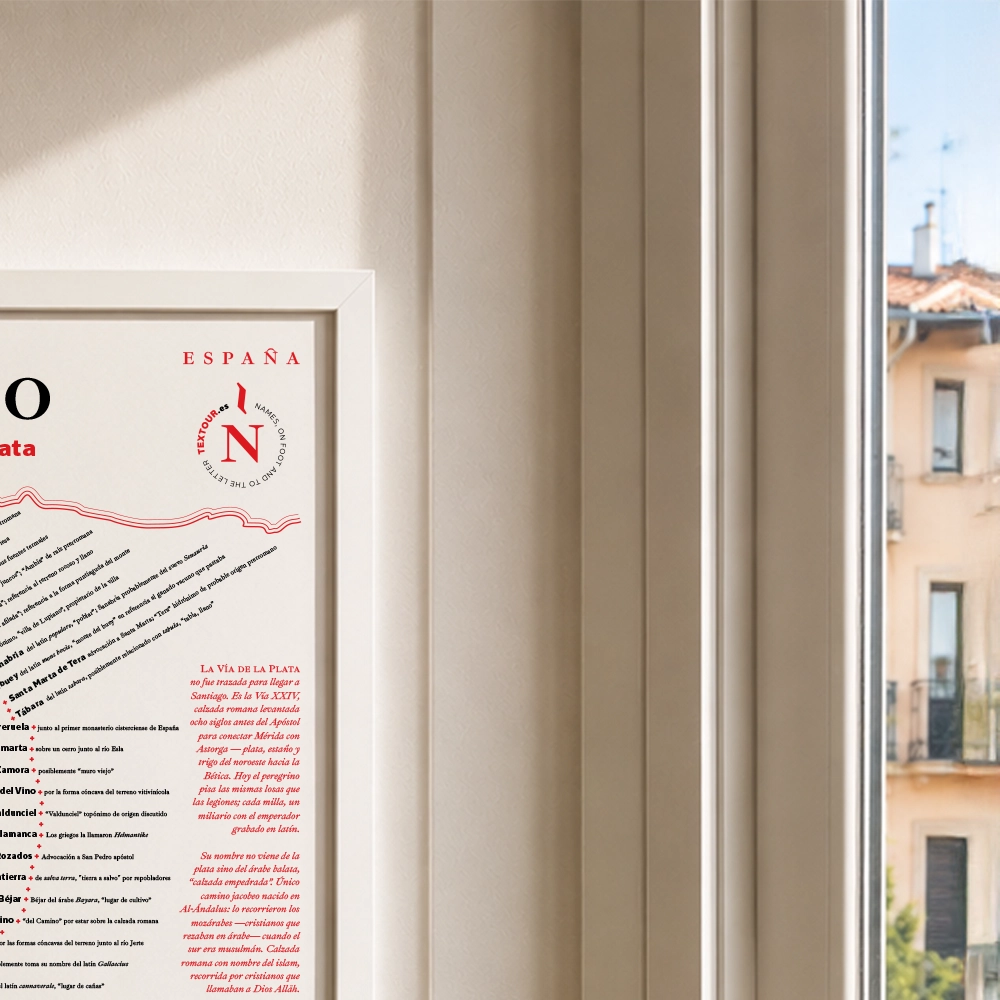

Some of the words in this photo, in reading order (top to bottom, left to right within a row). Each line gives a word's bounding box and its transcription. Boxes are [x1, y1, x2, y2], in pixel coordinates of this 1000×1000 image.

[183, 347, 299, 365] ESPAÑA
[254, 402, 280, 427] NAMES,
[197, 403, 230, 455] TEXTOUR.es
[277, 428, 286, 441] ON
[275, 442, 287, 467] FOOT
[202, 459, 229, 485] LETTER
[261, 465, 277, 482] AND
[230, 480, 247, 488] THE
[249, 478, 262, 488] TO
[201, 664, 214, 673] LA
[217, 664, 235, 673] VÍA
[269, 664, 300, 673] PLATA
[8, 685, 33, 702] Santa
[32, 672, 57, 688] Marta
[57, 665, 68, 674] de
[66, 654, 86, 667] Tera
[200, 678, 214, 688] fue
[216, 678, 247, 686] trazada
[248, 680, 268, 688] para
[270, 678, 294, 688] llegar
[191, 692, 228, 702] Santiago.
[231, 691, 242, 700] Es
[244, 692, 252, 700] la
[255, 691, 269, 700] Vía
[271, 691, 300, 700] XXIV,
[14, 699, 44, 717] Tábara
[194, 705, 224, 713] calzada
[260, 705, 300, 713] levantada
[0, 786, 14, 795] del
[15, 786, 36, 795] Vino
